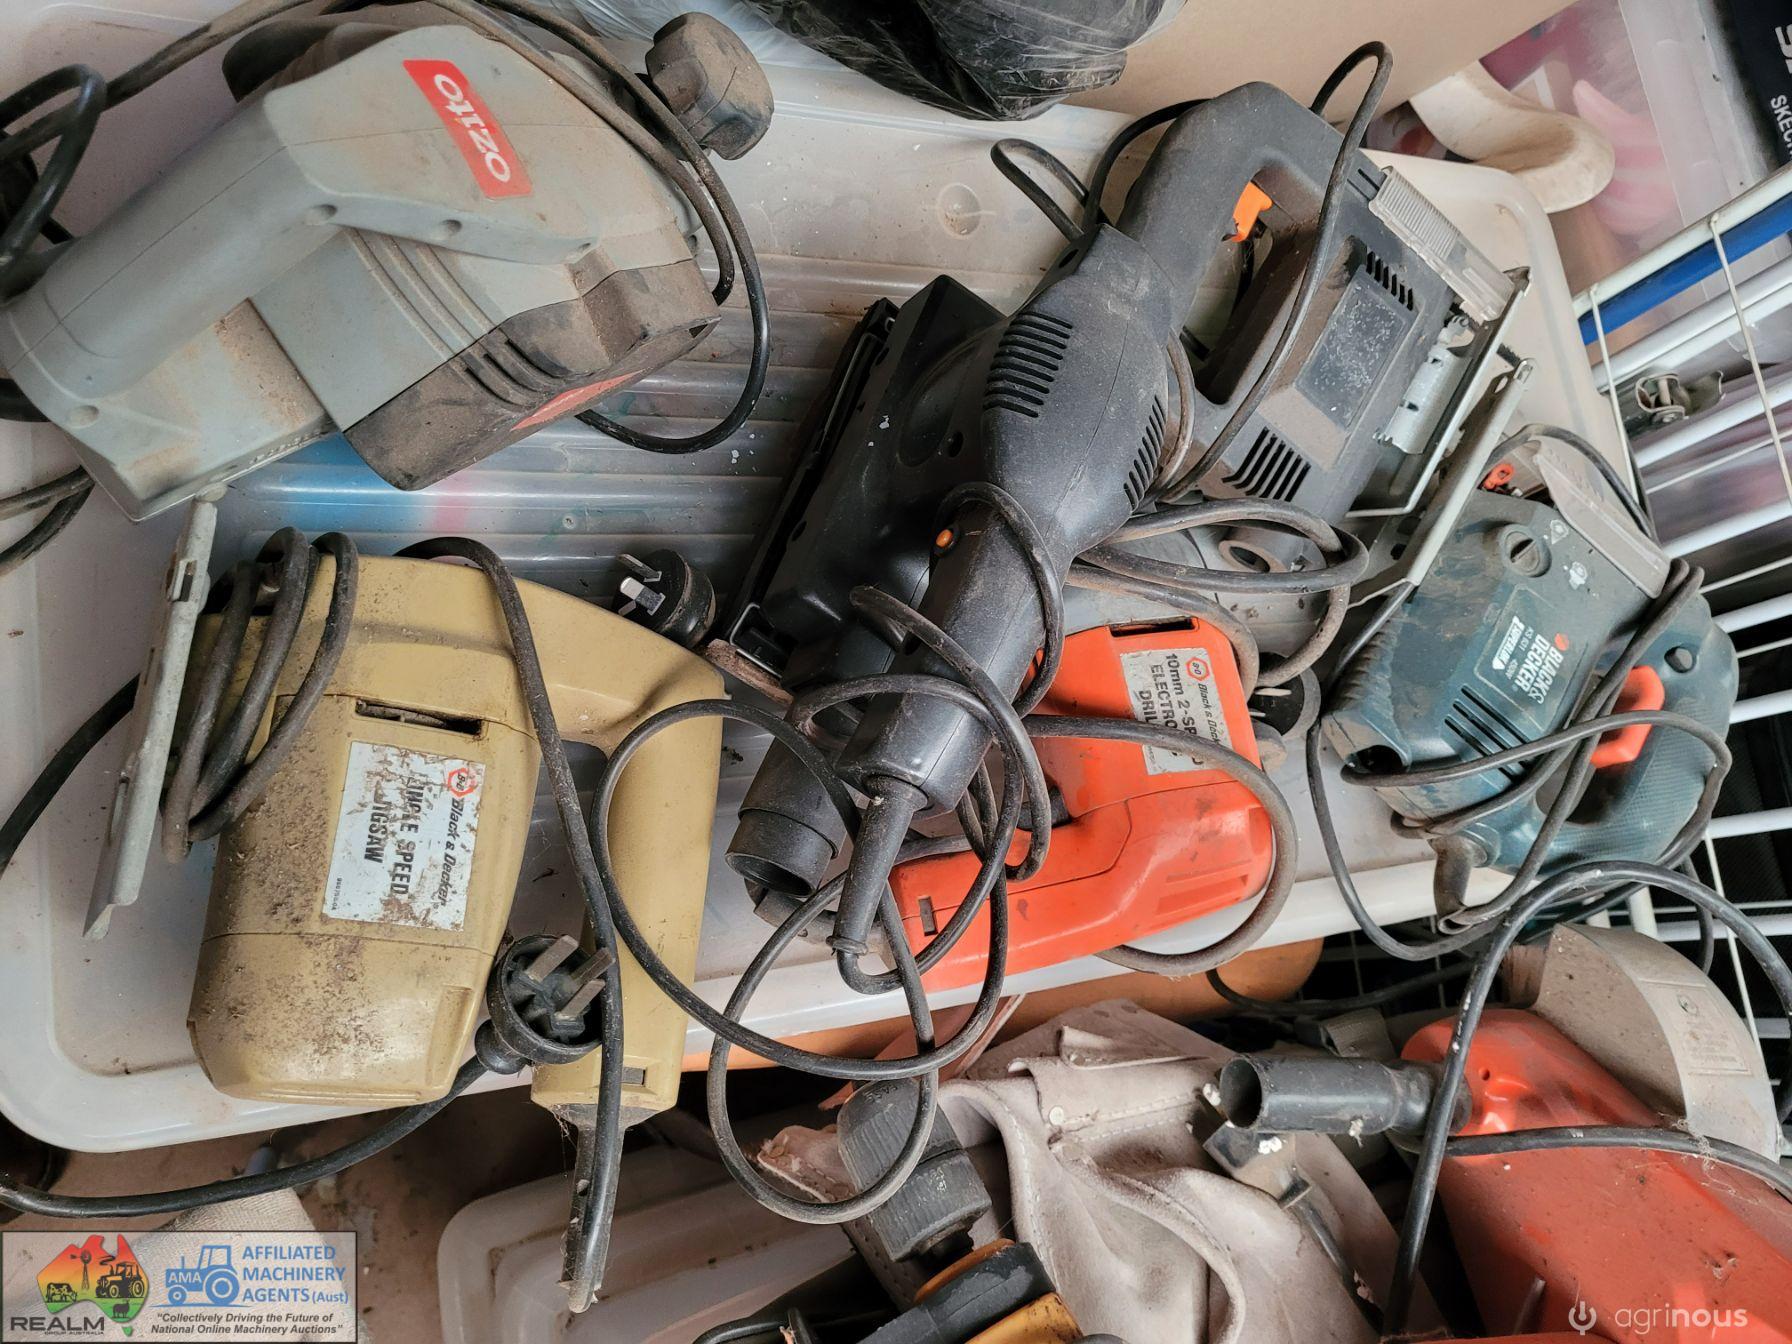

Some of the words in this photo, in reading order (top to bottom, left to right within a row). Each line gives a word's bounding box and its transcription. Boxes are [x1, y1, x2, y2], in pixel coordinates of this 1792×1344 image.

[1166, 654, 1185, 695] 10mm
[1514, 634, 1551, 692] DECKER
[1138, 690, 1158, 722] DRIL
[1150, 664, 1178, 755] ELECTRO
[446, 797, 465, 839] Black
[390, 839, 417, 894] SPEED
[437, 852, 457, 906] Decker
